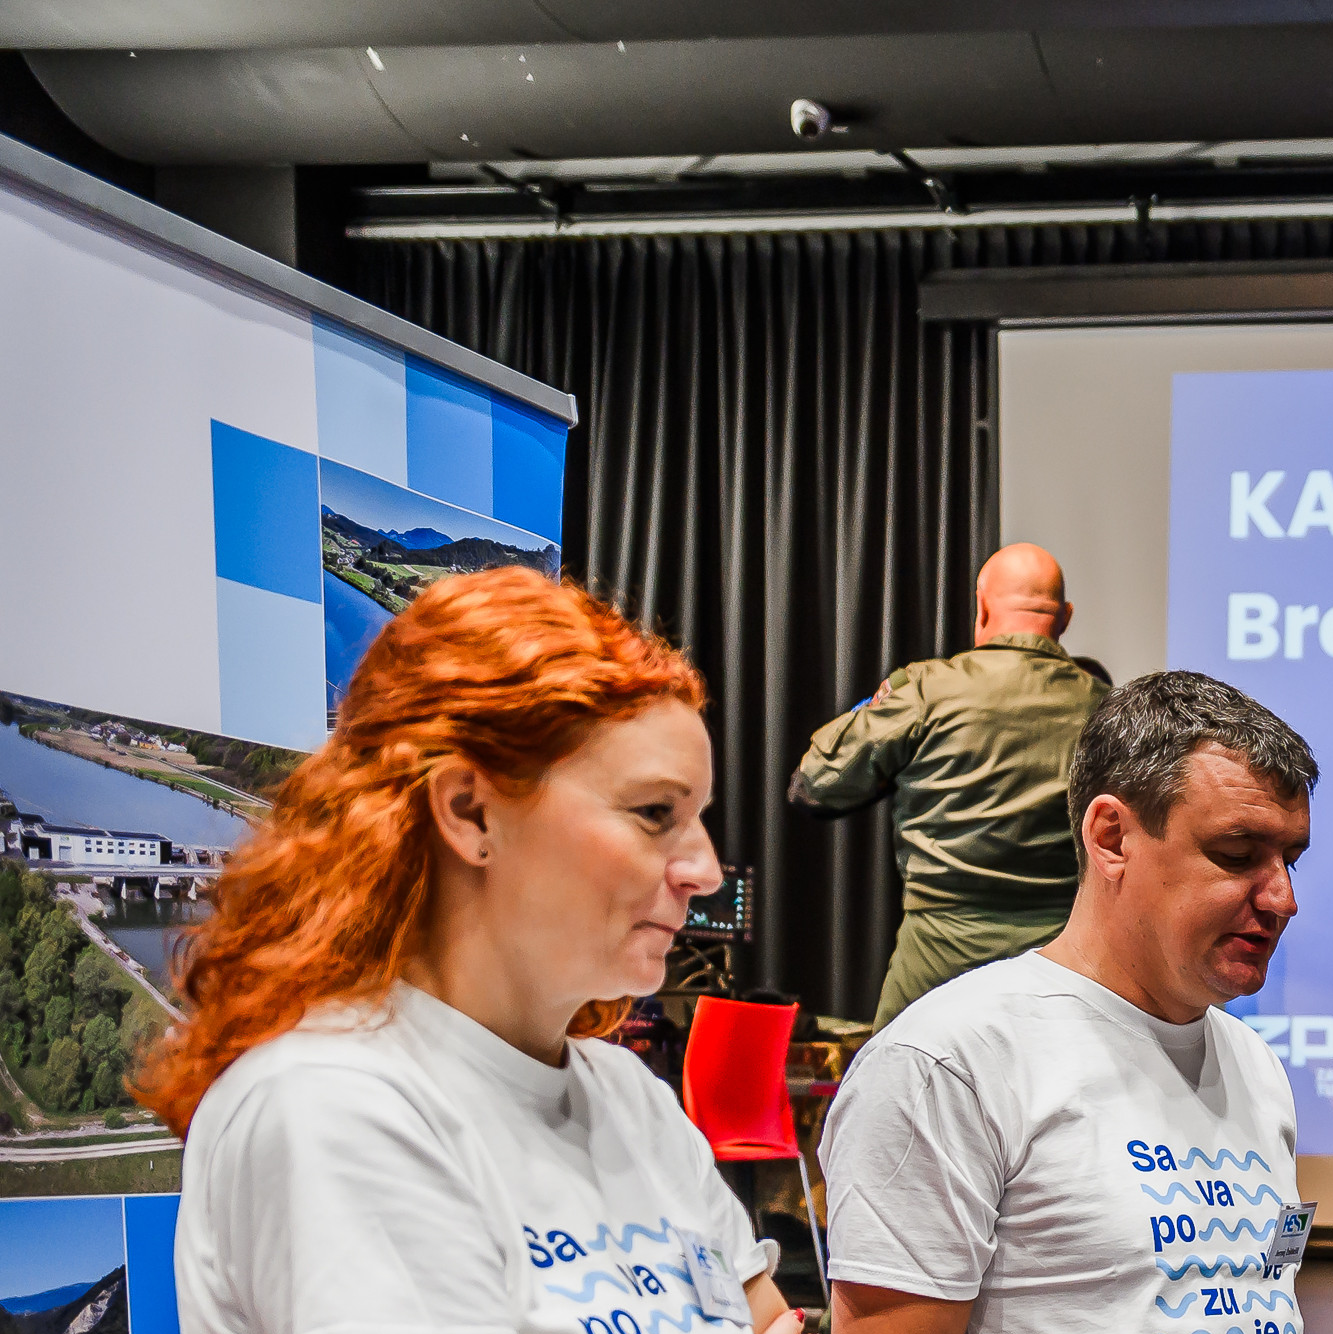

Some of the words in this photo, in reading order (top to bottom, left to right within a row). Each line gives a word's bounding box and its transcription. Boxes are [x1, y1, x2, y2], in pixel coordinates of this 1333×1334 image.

[1126, 1139, 1178, 1172] Sa
[1195, 1179, 1235, 1207] va
[522, 1223, 588, 1269] Sa
[1150, 1214, 1196, 1253] po
[616, 1262, 668, 1297] va
[1201, 1288, 1241, 1317] zu
